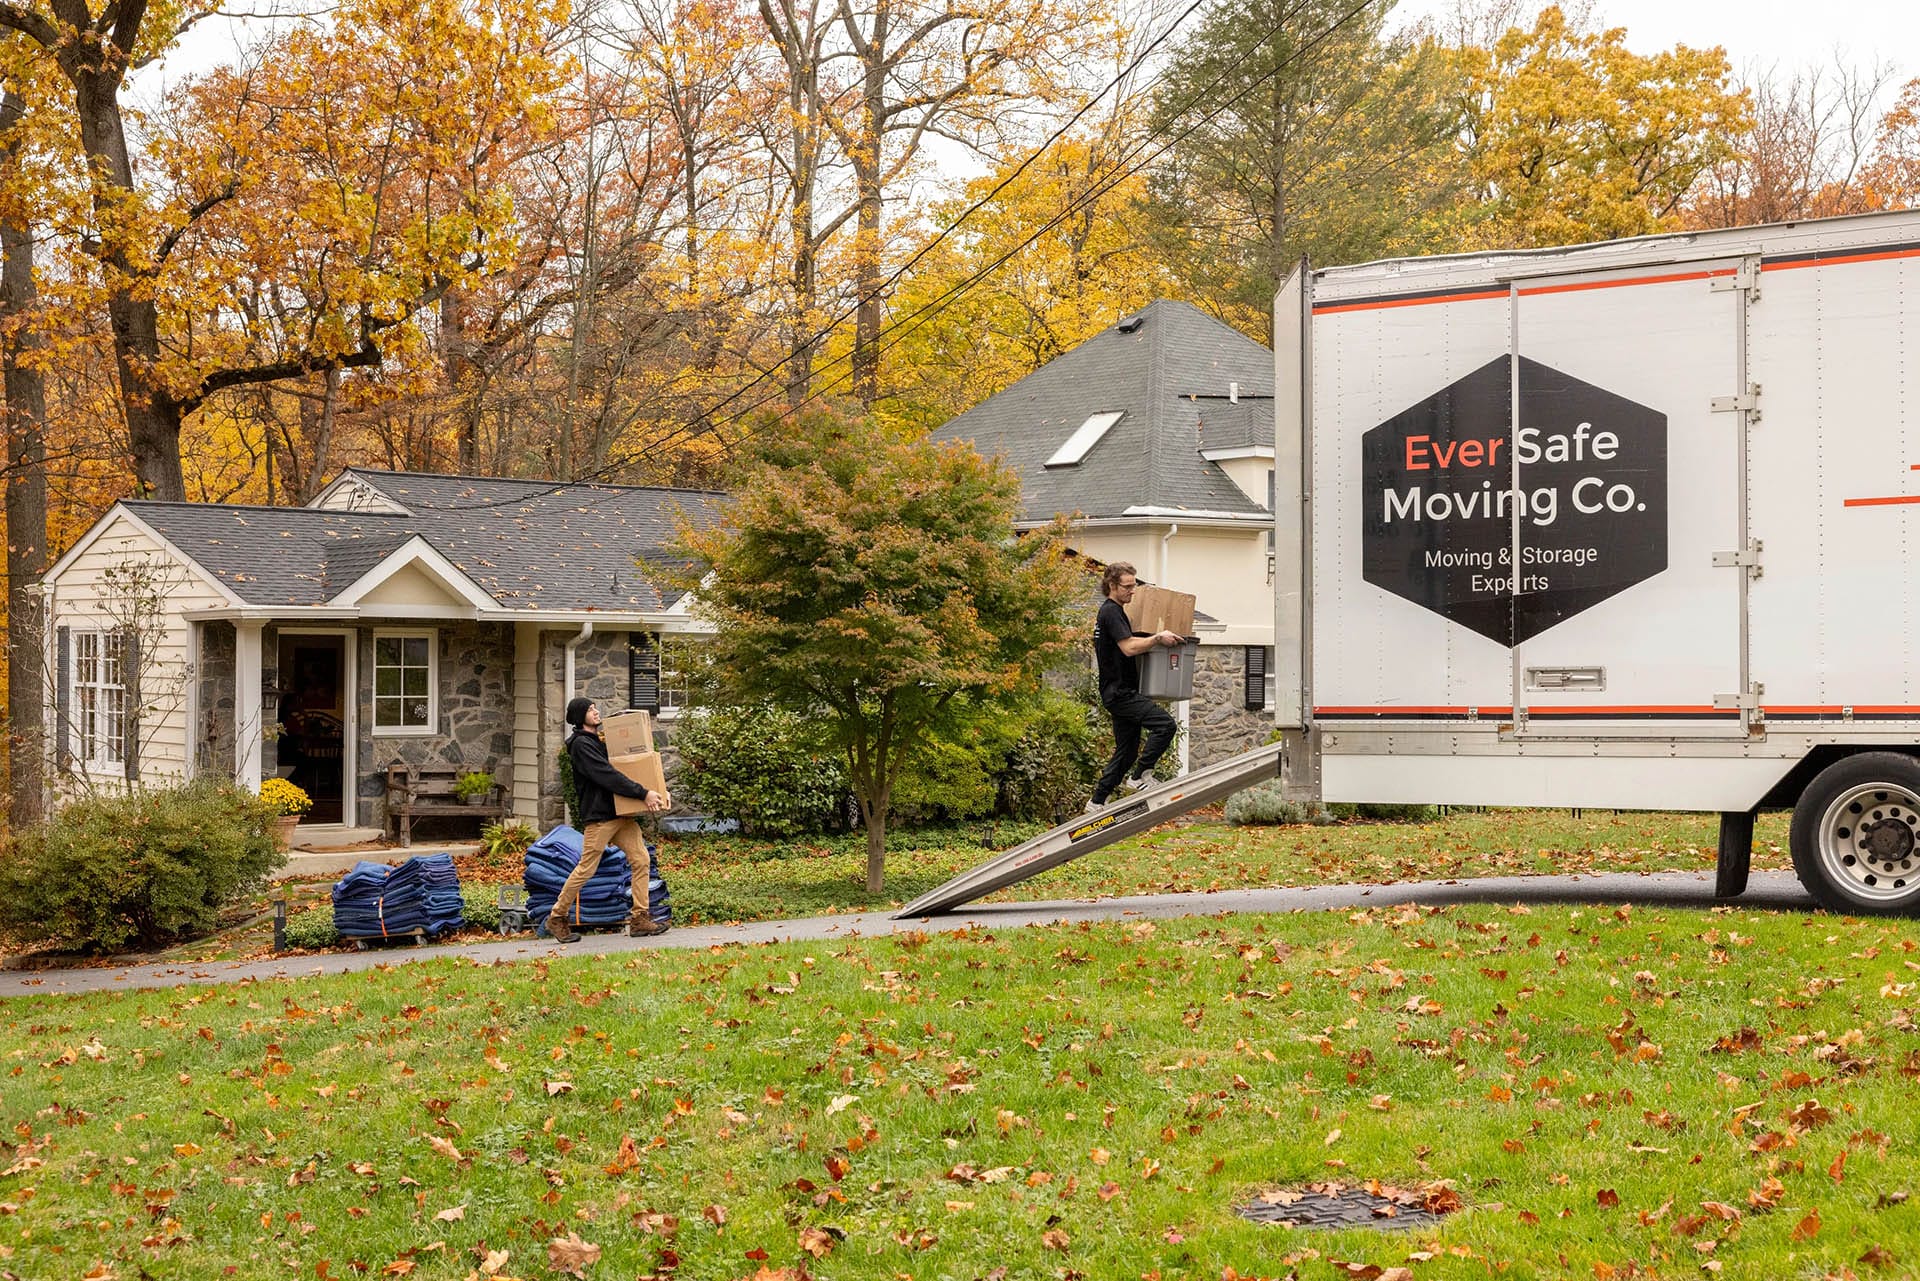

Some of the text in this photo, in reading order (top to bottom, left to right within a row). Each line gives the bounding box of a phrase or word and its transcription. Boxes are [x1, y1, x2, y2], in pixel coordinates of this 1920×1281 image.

[1405, 422, 1620, 471] Ever Safe
[1383, 476, 1647, 526] Moving Co.
[1425, 547, 1598, 569] Moving & Storage
[1471, 574, 1549, 594] Experts
